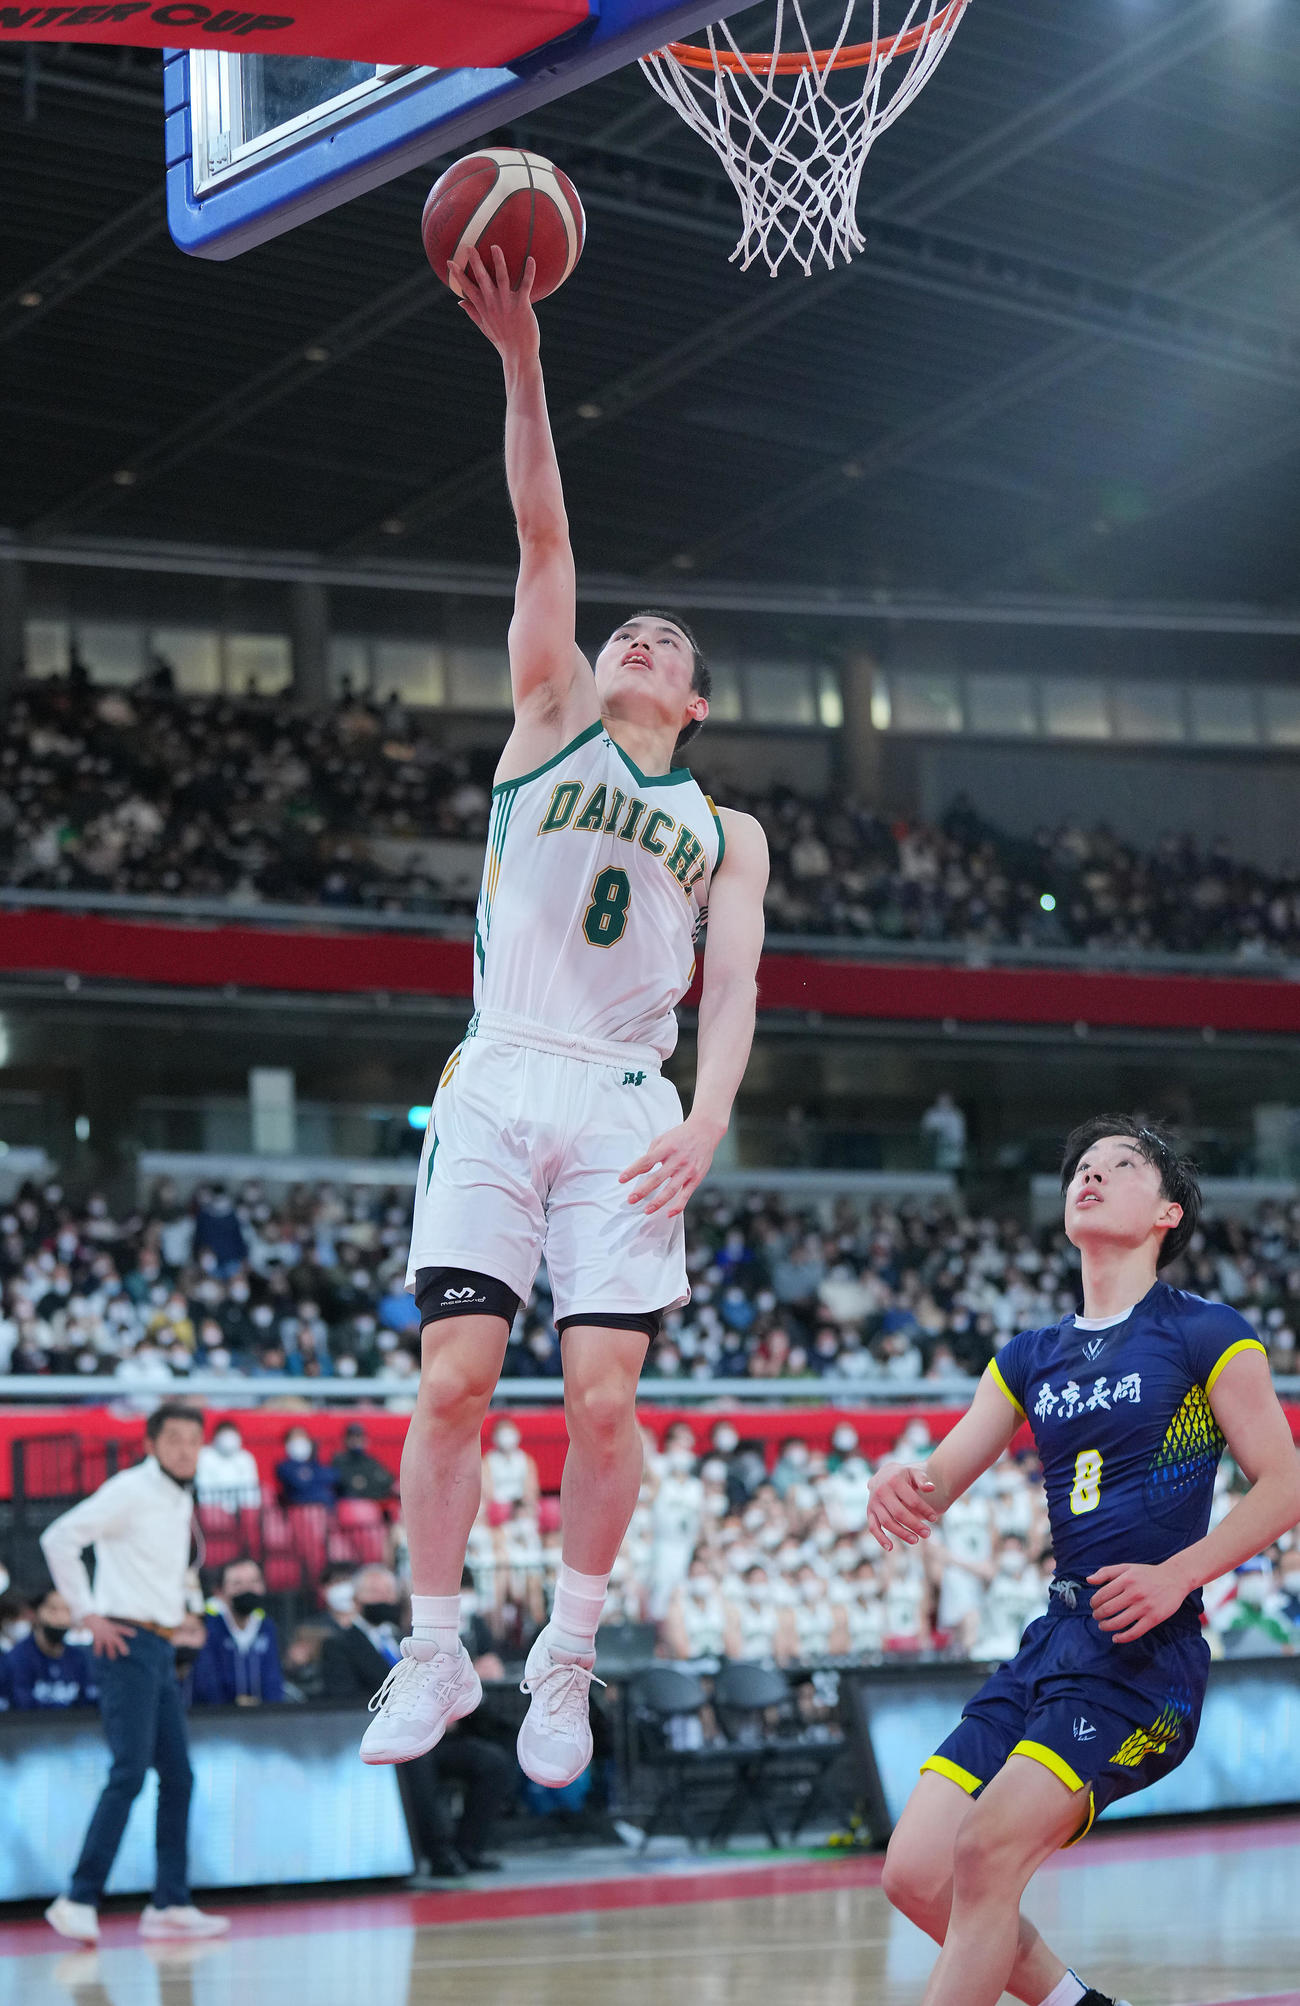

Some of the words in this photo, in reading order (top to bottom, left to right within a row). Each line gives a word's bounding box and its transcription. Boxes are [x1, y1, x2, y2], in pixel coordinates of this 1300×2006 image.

[150, 3, 295, 36] CUP
[582, 865, 631, 948] 8
[1034, 1372, 1141, 1423] 帝京長岡
[1070, 1449, 1104, 1515] 8
